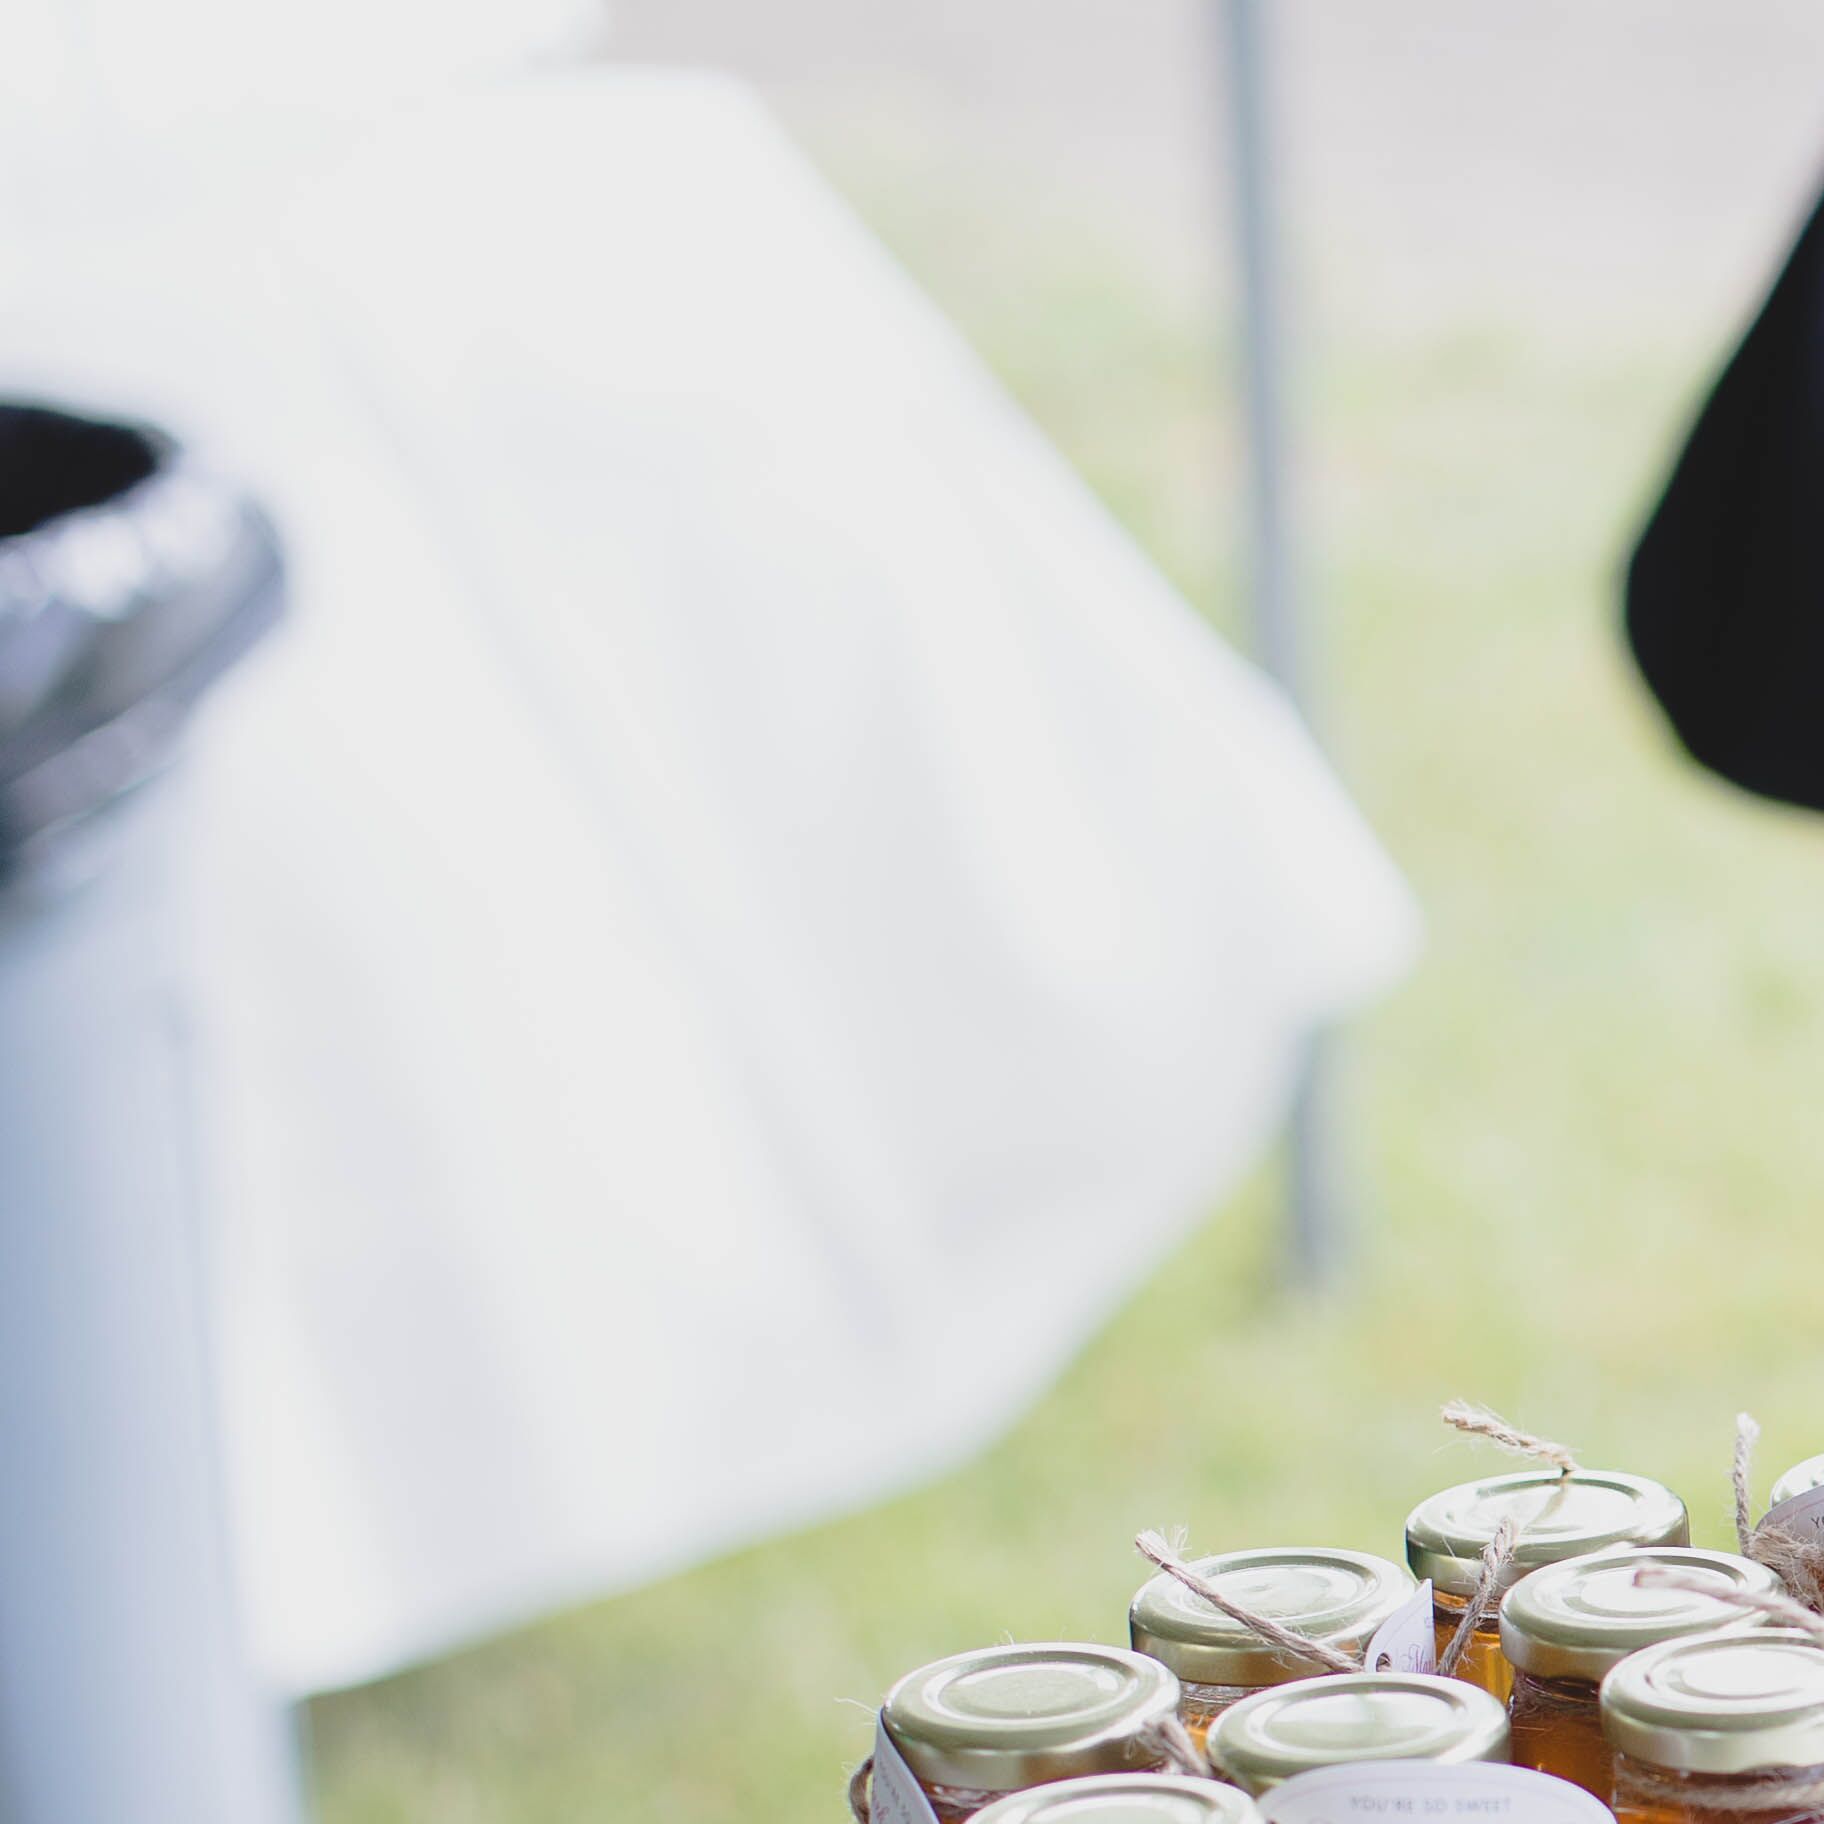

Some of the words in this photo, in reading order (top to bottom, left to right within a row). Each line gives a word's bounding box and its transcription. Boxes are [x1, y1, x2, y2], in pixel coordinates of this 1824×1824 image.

[1350, 1796, 1415, 1812] YOU'RE
[1424, 1797, 1448, 1812] SO
[1456, 1796, 1512, 1812] SWEET
